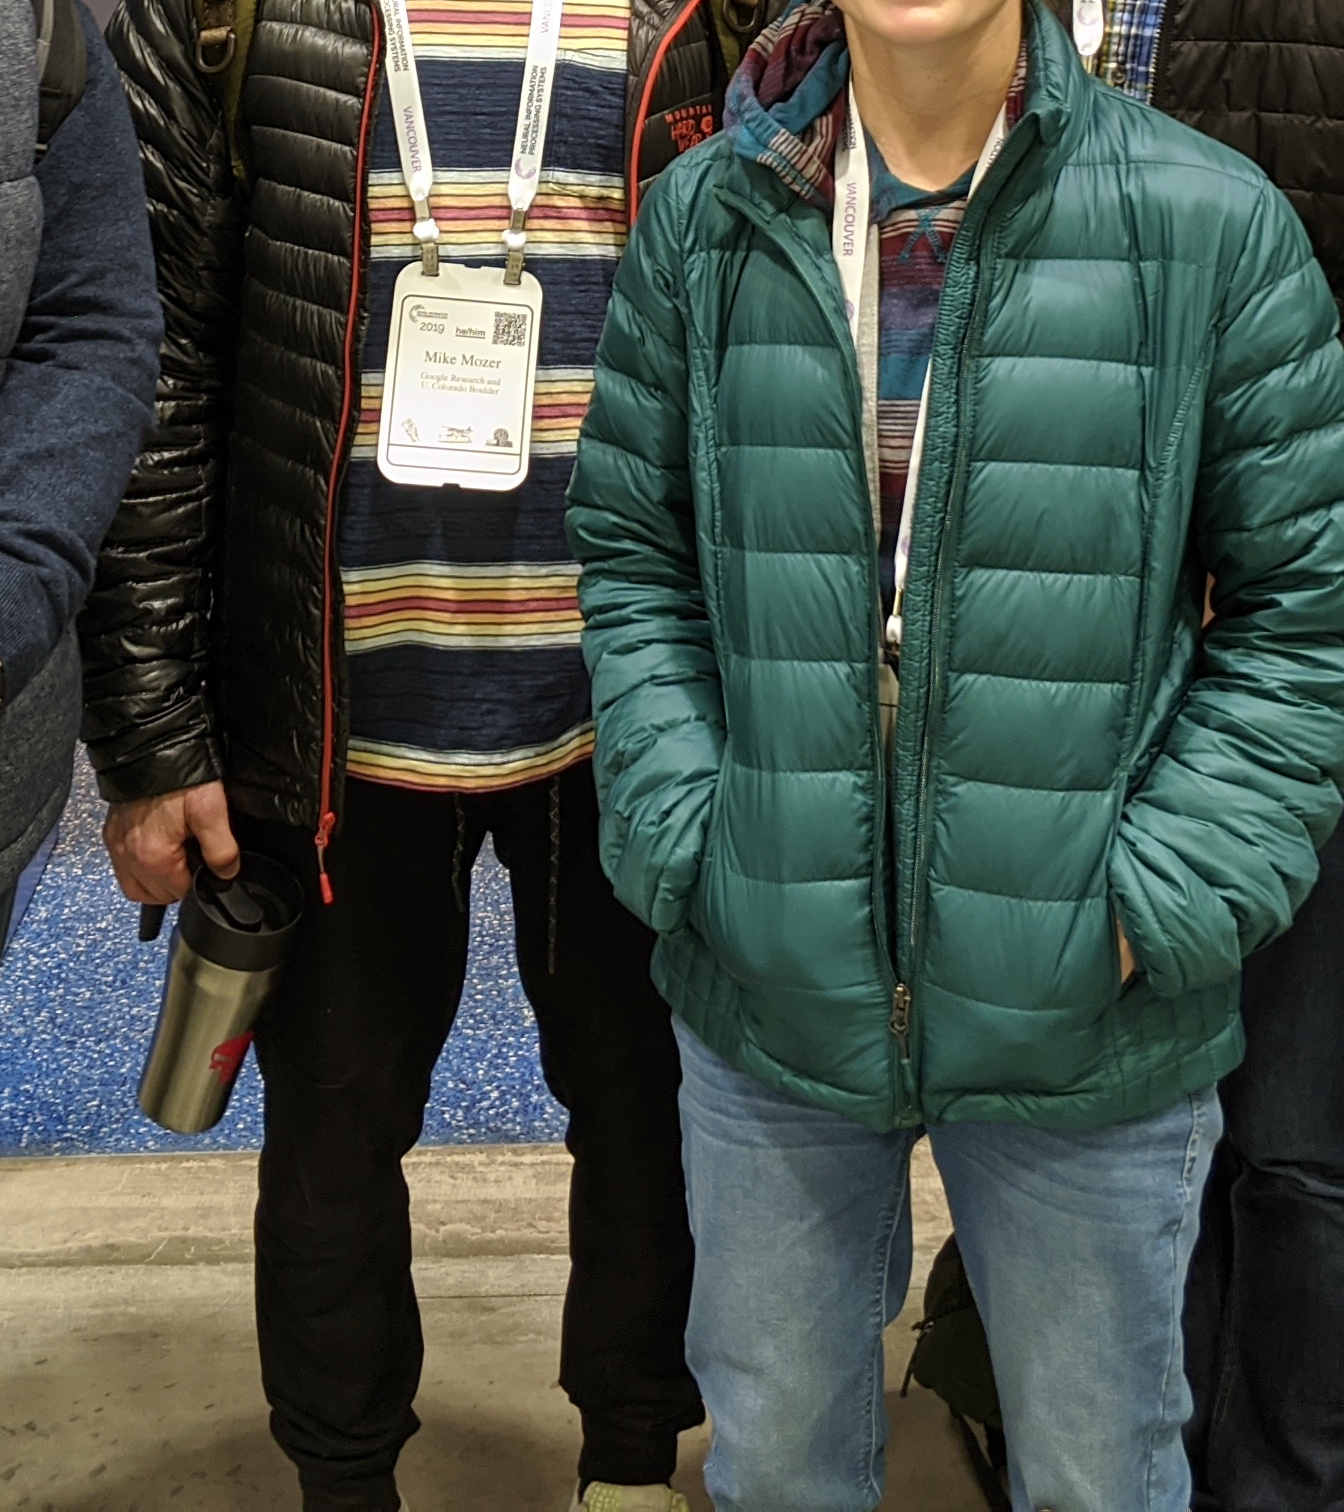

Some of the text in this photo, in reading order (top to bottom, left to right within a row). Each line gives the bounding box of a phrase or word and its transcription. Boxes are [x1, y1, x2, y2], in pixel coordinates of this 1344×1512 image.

[389, 36, 401, 73] SYSTEMS
[396, 19, 410, 72] INFORMATION
[520, 65, 538, 155] NEURAL INFORMATION
[528, 66, 547, 156] PROCESSING SYSTEMS
[664, 104, 712, 123] MOUNTAI
[402, 106, 422, 173] VANCOUVER
[843, 182, 857, 257] VANCOUVER
[420, 322, 486, 337] 2019 he/him
[424, 350, 502, 369] Mike Mozer
[420, 371, 501, 386] Google Research and
[432, 381, 467, 392] Colorado
[469, 385, 499, 395] Boulder
